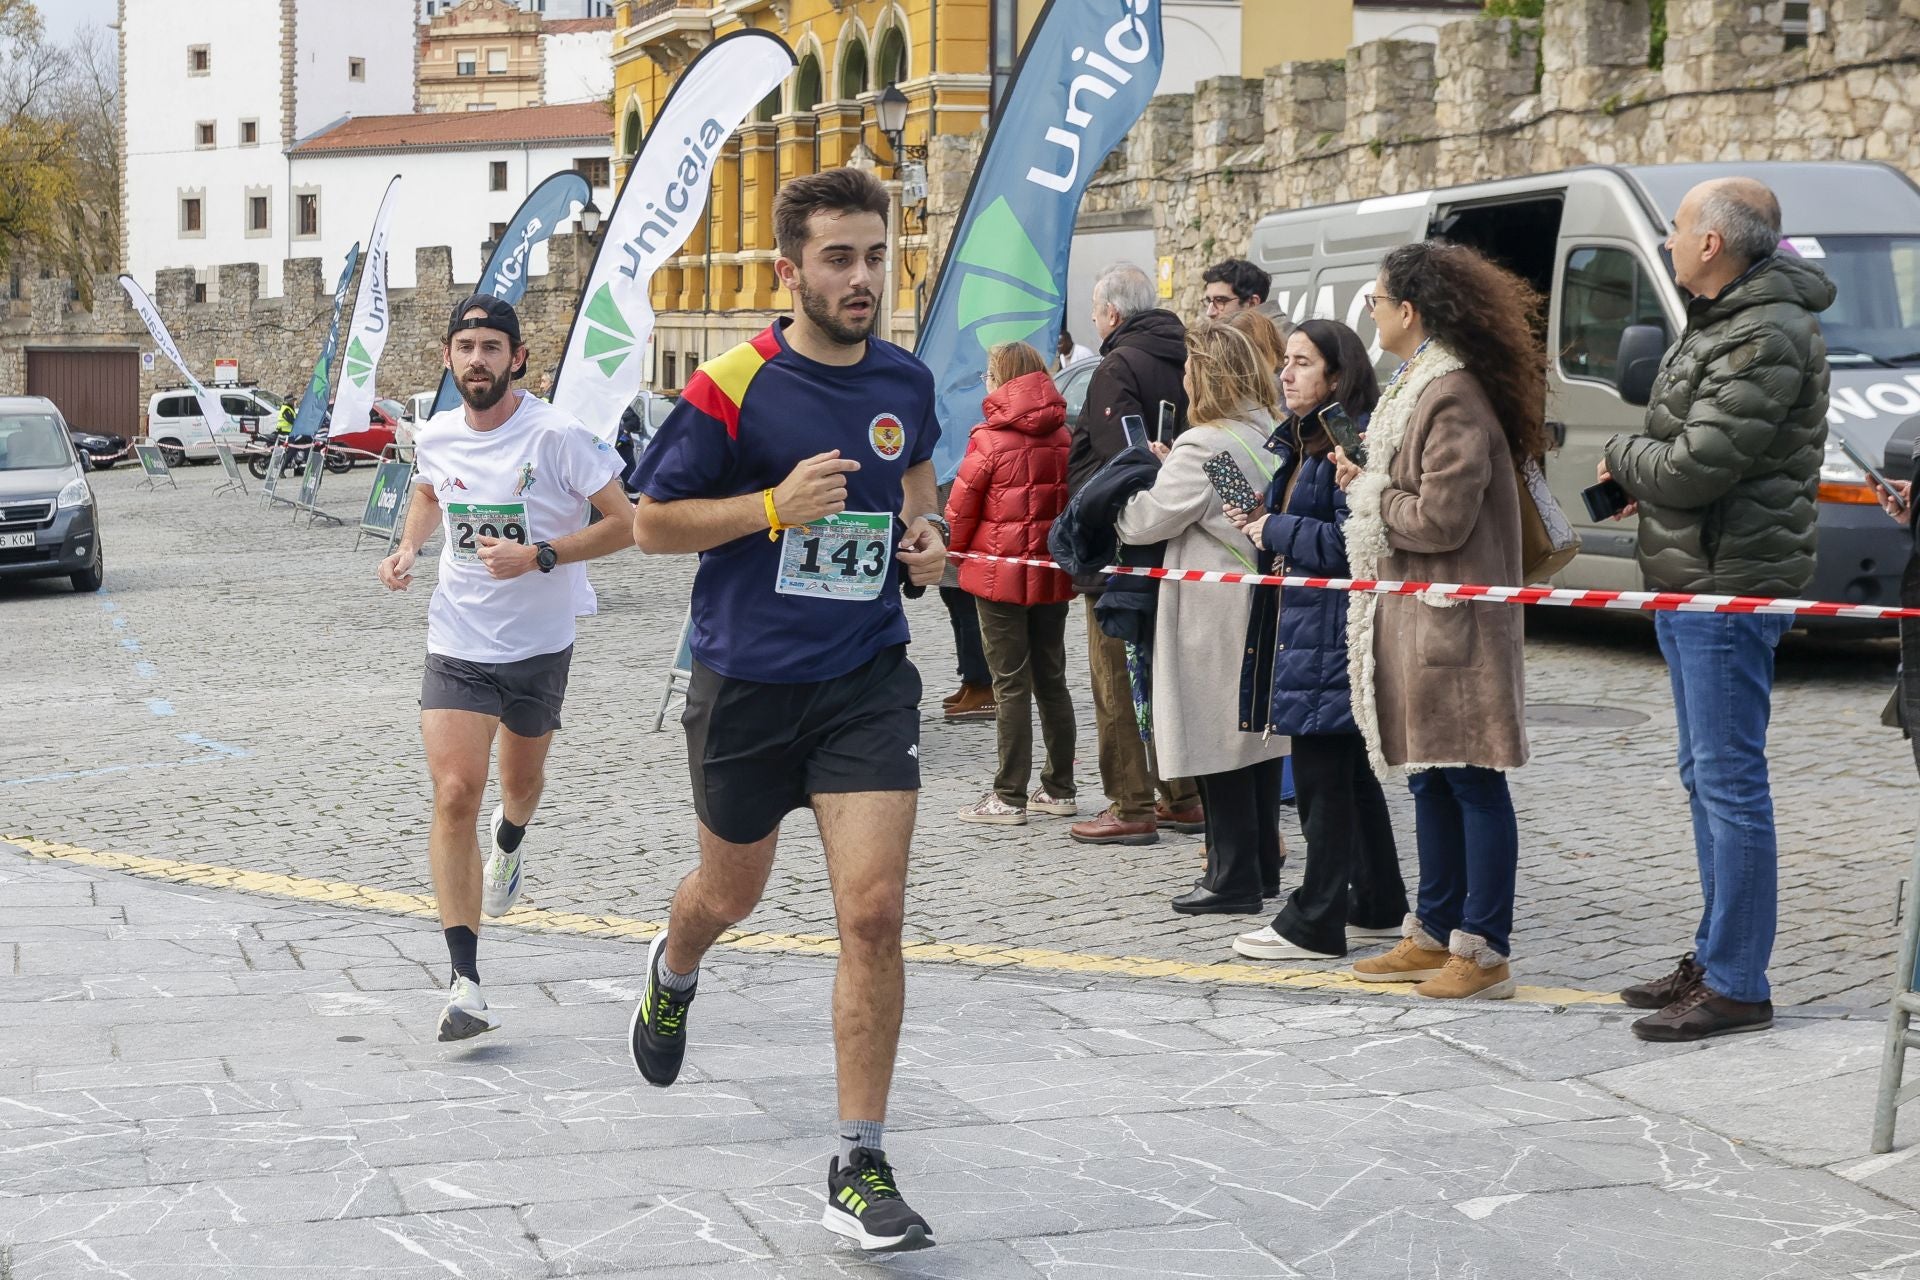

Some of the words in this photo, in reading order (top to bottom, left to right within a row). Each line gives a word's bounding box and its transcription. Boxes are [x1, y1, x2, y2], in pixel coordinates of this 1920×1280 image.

[1026, 0, 1150, 193] Unic
[619, 118, 725, 281] Unicaja
[799, 537, 886, 577] 143
